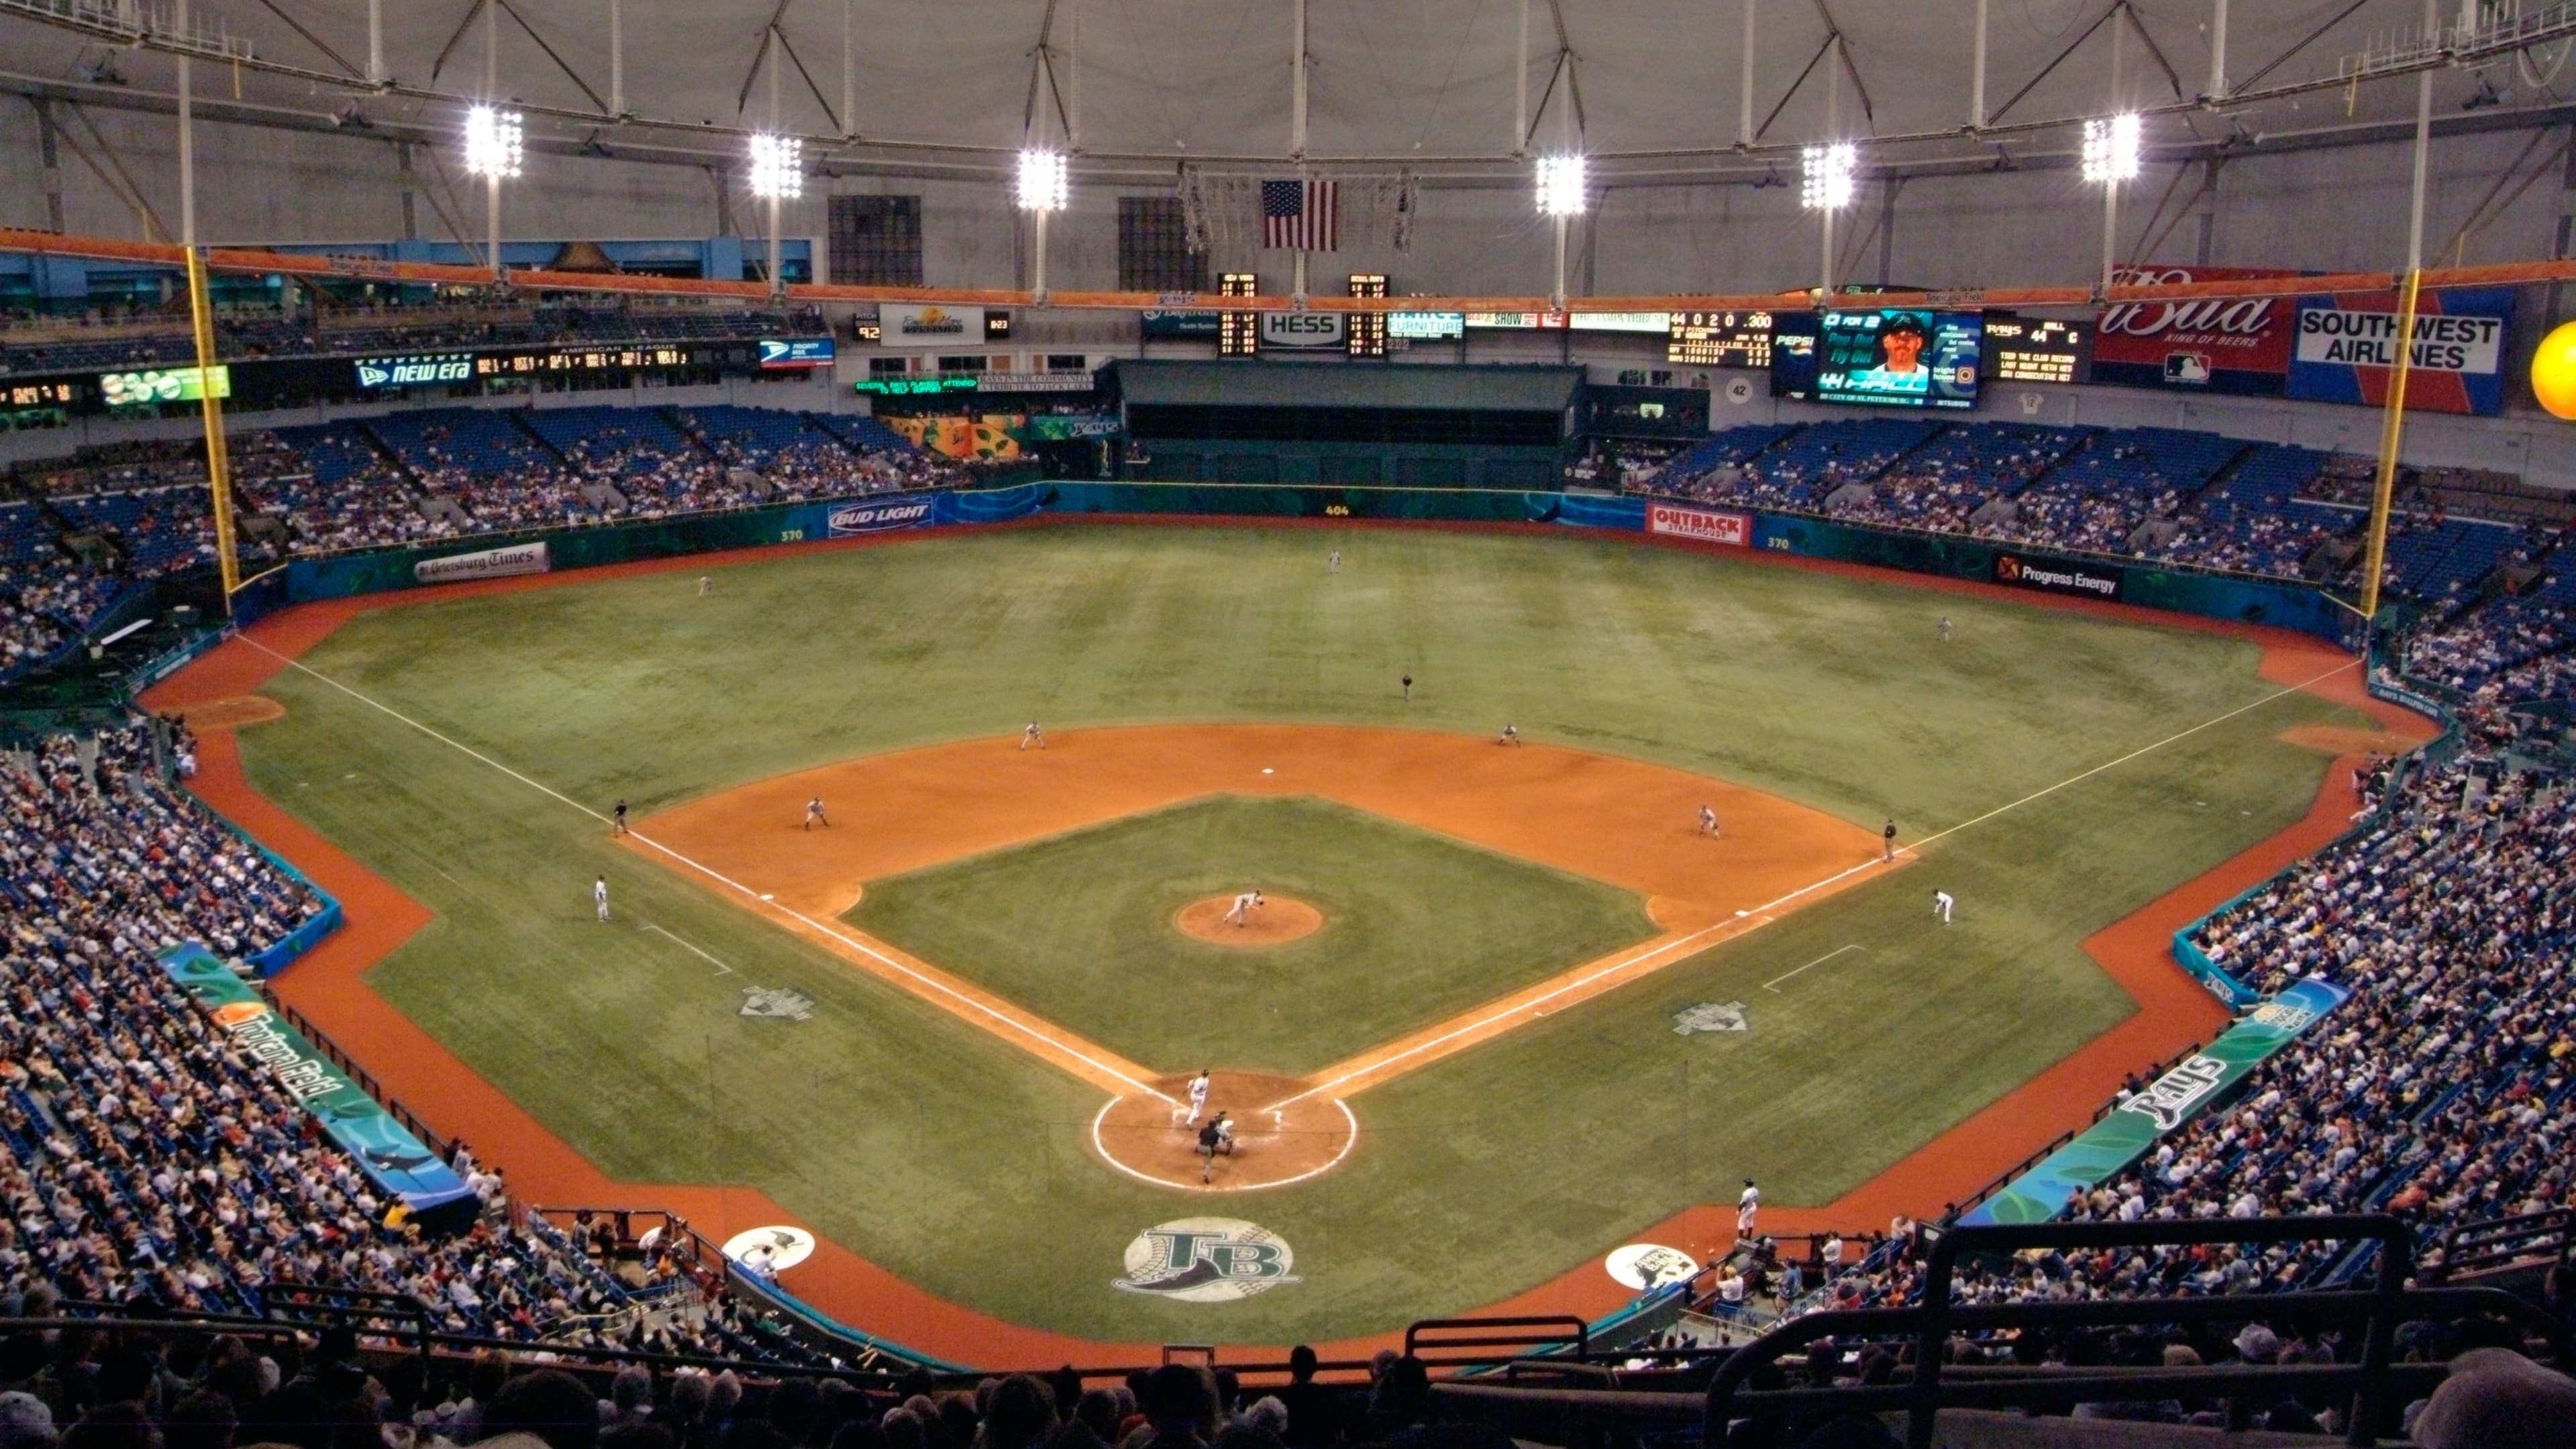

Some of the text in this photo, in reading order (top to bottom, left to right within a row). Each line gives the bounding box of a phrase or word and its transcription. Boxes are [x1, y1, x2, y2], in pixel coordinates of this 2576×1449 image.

[1271, 316, 1335, 333] HESS
[1494, 313, 1523, 325] SHOW
[1671, 313, 1772, 328] 44 0 2 0 .300
[1843, 317, 1863, 326] FOR
[1864, 315, 1881, 328] 2
[1388, 321, 1463, 332] FURNITURE
[2043, 322, 2065, 331] HALL
[2302, 311, 2499, 344] SOUTHWEST
[859, 327, 880, 339] 92
[2030, 330, 2047, 342] 44
[2164, 333, 2216, 344] KING OF
[1775, 335, 1815, 346] PEPSI
[560, 345, 621, 354] AMERICAN
[2000, 352, 2076, 363] TIED THE CLUB RECORD
[2001, 361, 2017, 369] LAST
[2041, 363, 2057, 371] WITH
[1819, 372, 1928, 392] 44 HALL
[2014, 371, 2057, 381] CONSECUTIVE
[2058, 374, 2071, 382] HIT
[1733, 386, 1746, 396] 42
[1867, 395, 1910, 404] PETERSBURG
[835, 504, 929, 526] BUD LIGHT
[1325, 505, 1349, 516] 404
[1655, 509, 1739, 533] OUTBACK
[780, 529, 803, 542] 370
[1668, 524, 1727, 539] STEAKHOUSE
[1767, 536, 1790, 550] 370
[488, 550, 534, 567] Times
[2022, 566, 2116, 594] Progress Energy
[279, 1059, 345, 1100] Field
[1141, 1228, 1284, 1277] TB
